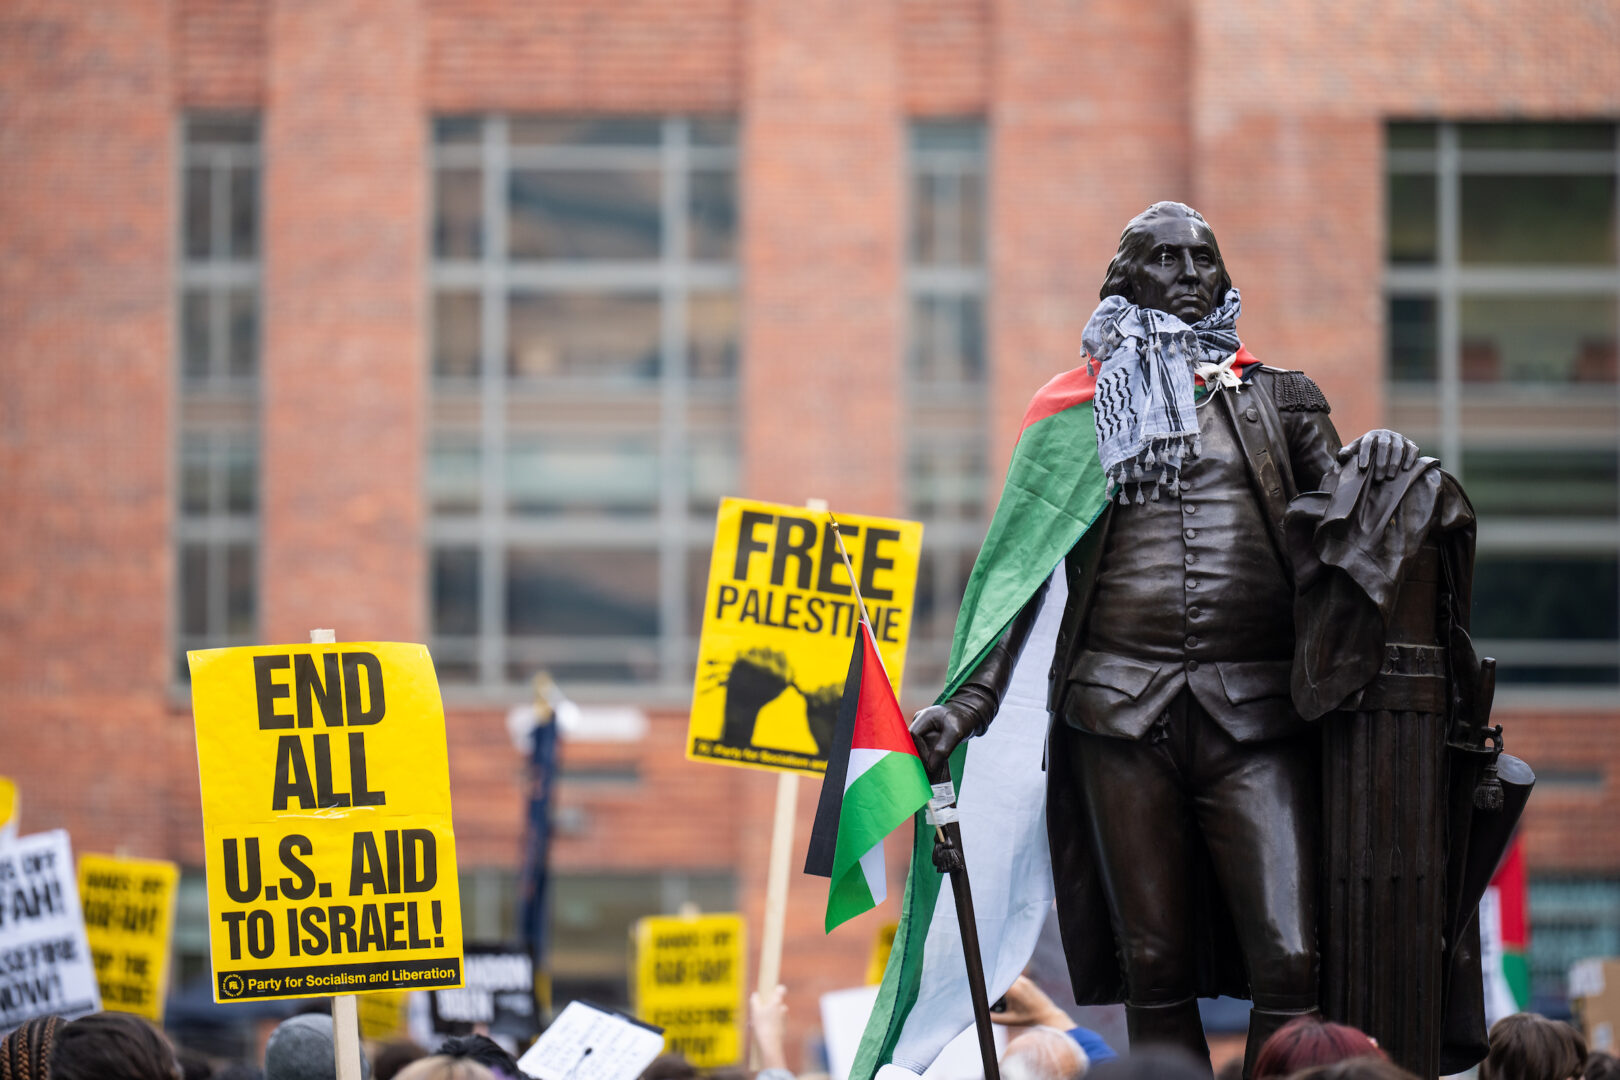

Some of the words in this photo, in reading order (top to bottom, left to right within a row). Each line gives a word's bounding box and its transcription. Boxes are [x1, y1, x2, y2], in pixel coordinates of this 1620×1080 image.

[733, 510, 901, 601] FREE
[253, 652, 386, 730] END
[272, 732, 386, 810] ALL
[222, 834, 332, 903] U.S.
[349, 829, 437, 896] AID
[221, 909, 275, 960] TO
[287, 900, 444, 956] ISRAEL!
[248, 977, 282, 992] Party
[285, 975, 303, 988] for
[306, 972, 366, 987] Socialism
[369, 971, 389, 983] and
[392, 967, 455, 982] Liberation
